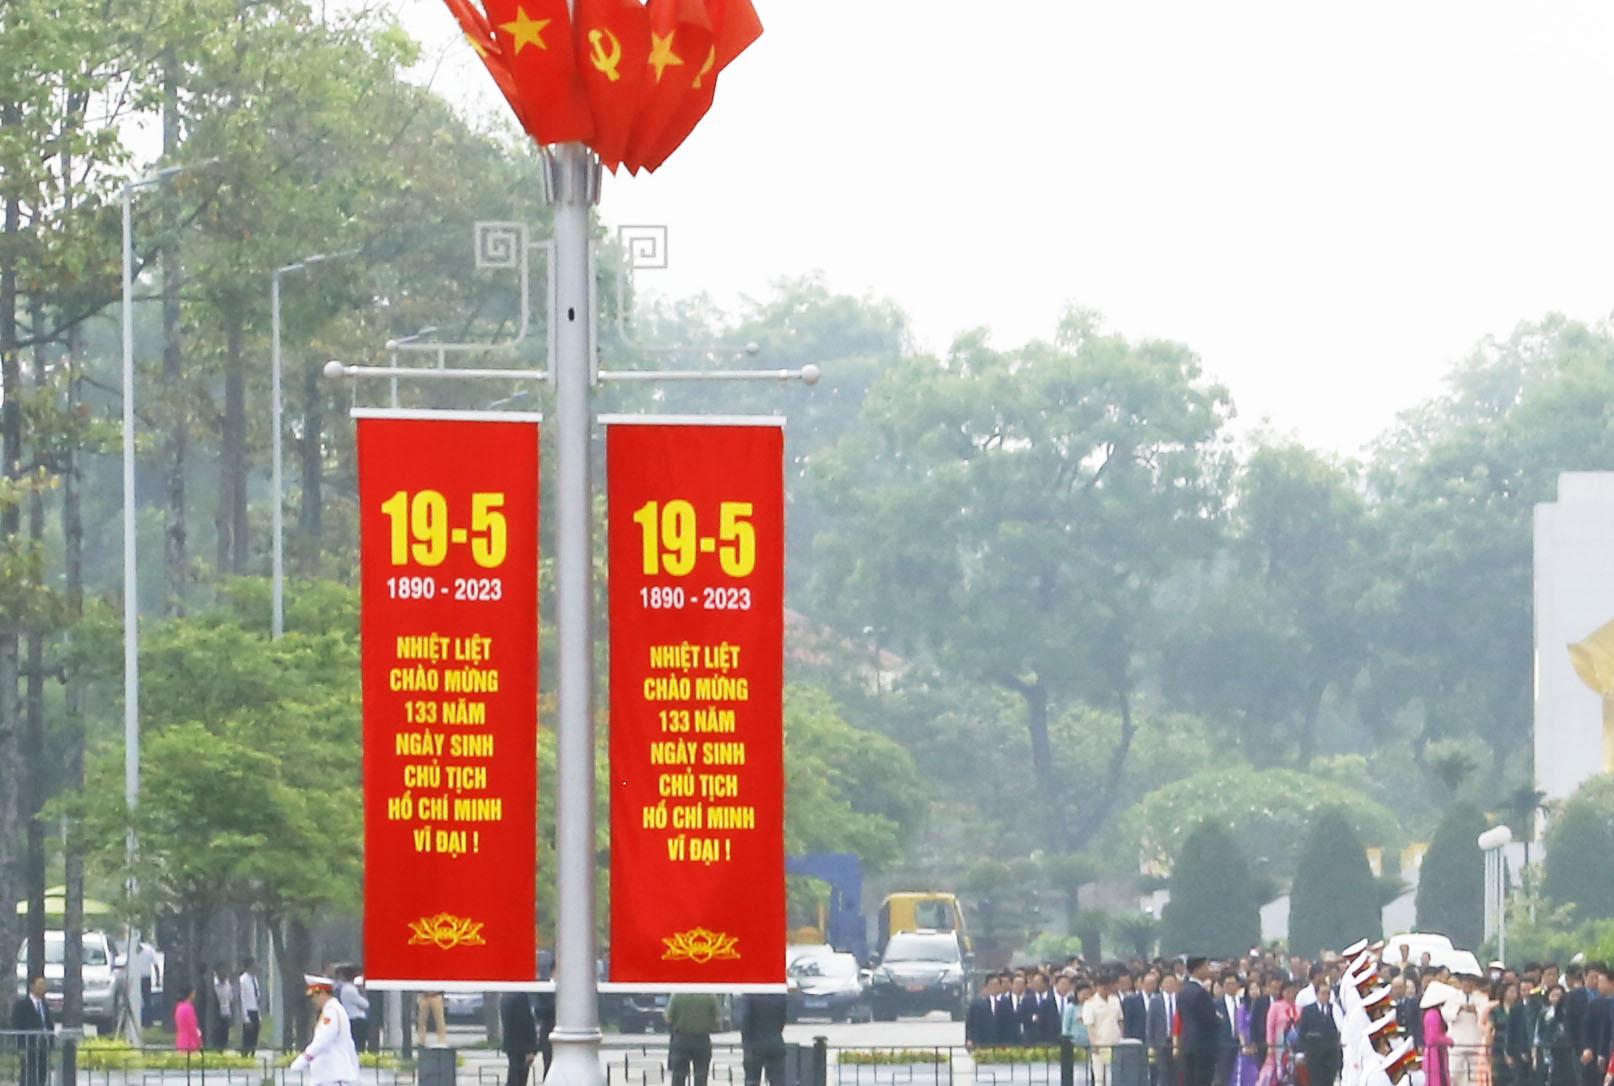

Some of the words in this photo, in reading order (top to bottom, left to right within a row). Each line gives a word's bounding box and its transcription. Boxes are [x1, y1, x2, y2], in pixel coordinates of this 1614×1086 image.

[380, 490, 508, 568] 19-5
[632, 500, 757, 577] 19-5
[386, 577, 435, 600] 1890
[454, 577, 502, 601] 2023
[639, 587, 685, 611] 1890
[703, 587, 752, 611] 2023
[397, 632, 450, 665] NHIỆT
[454, 633, 492, 666] LIỆT
[650, 641, 700, 673] NHIỆT
[704, 641, 741, 674] LIỆT
[389, 664, 439, 692] CHÀO
[444, 666, 499, 693] MỪNG
[643, 673, 691, 701] CHÀO
[695, 673, 749, 701] MỪNG
[405, 700, 438, 723] 133
[442, 698, 485, 725] NĂM
[658, 709, 690, 732] 133
[694, 706, 736, 733] NĂM
[395, 728, 445, 756] NGÀY
[450, 734, 494, 757] SINH
[651, 737, 698, 765] NGÀY
[702, 742, 746, 765] SINH
[404, 758, 441, 788] CHỦ
[445, 766, 487, 794] TỊCH
[659, 766, 695, 797] CHỦ
[699, 774, 738, 802] TỊCH
[418, 794, 449, 821] CHÍ
[454, 798, 502, 822] MINH
[672, 801, 703, 829] CHÍ
[707, 806, 755, 829] MINH
[413, 826, 432, 852] VĨ
[435, 830, 467, 859] ĐẠI
[667, 834, 686, 861] VĨ
[689, 838, 720, 867] ĐẠI
